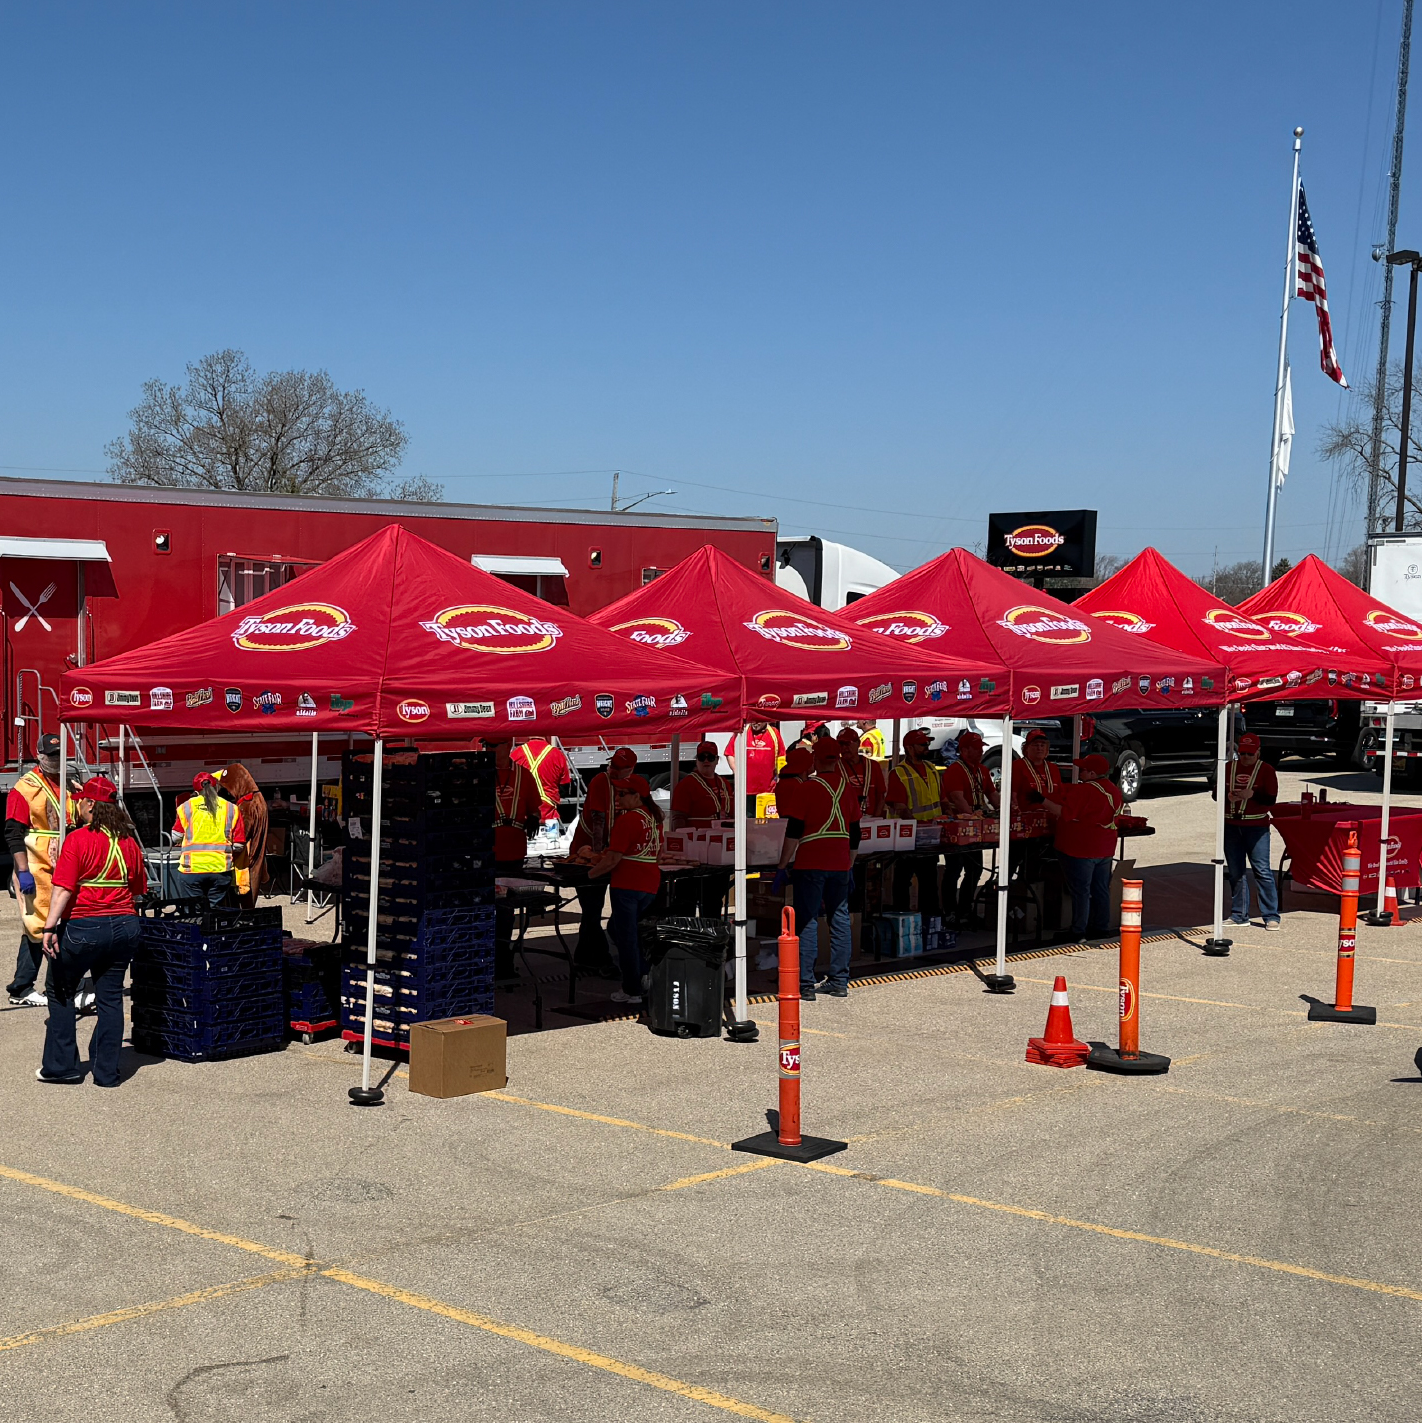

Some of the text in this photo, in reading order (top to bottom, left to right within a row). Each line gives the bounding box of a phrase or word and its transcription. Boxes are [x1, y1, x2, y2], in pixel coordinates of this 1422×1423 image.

[1004, 533, 1064, 549] Tyson Foods
[241, 617, 350, 639] Tyson Foods
[428, 619, 558, 640] Tyson Foods
[885, 623, 945, 638] Foods
[1269, 621, 1318, 633] Foods
[73, 691, 92, 704] Tyson
[401, 703, 428, 718] Tyson
[672, 981, 680, 1010] TYSON
[780, 1050, 800, 1069] Tys
